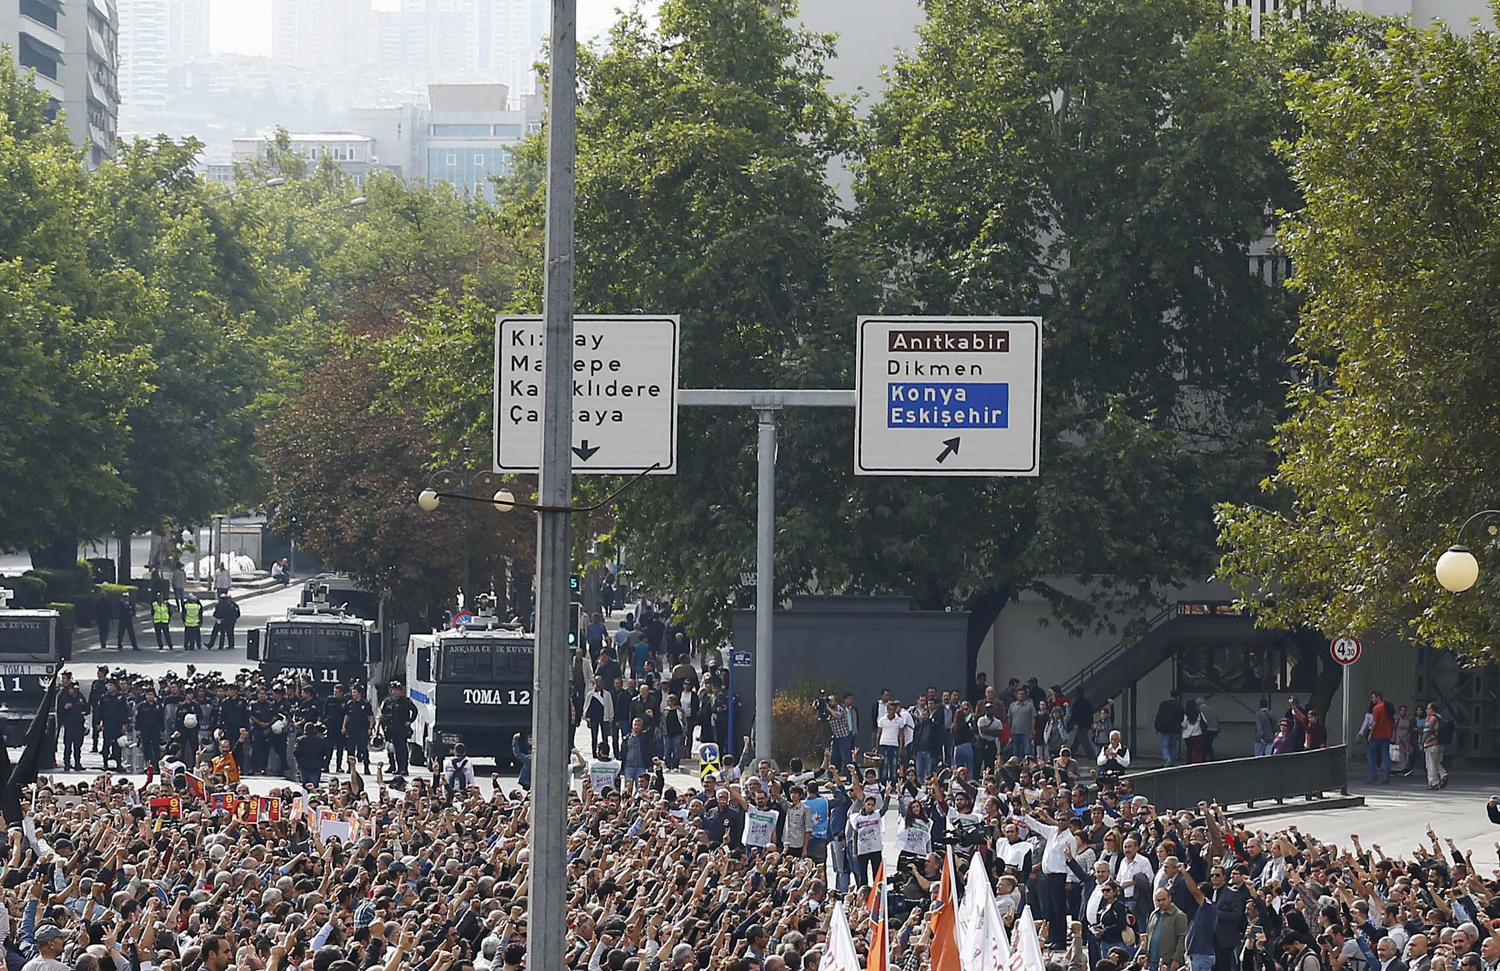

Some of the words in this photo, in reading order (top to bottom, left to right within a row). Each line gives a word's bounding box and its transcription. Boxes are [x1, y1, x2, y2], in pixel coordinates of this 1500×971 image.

[893, 333, 1006, 350] Anıtkabir
[510, 355, 621, 376] Maepe
[888, 360, 983, 376] Dikmen
[510, 380, 661, 397] Kaklıdere
[891, 385, 967, 405] Konya
[510, 405, 624, 426] Çaaya
[891, 407, 1002, 427] Eskişehir
[506, 646, 534, 654] KUVVE
[12, 677, 23, 691] 1
[321, 669, 340, 683] 11
[463, 688, 502, 705] TOMA
[508, 690, 530, 705] 12
